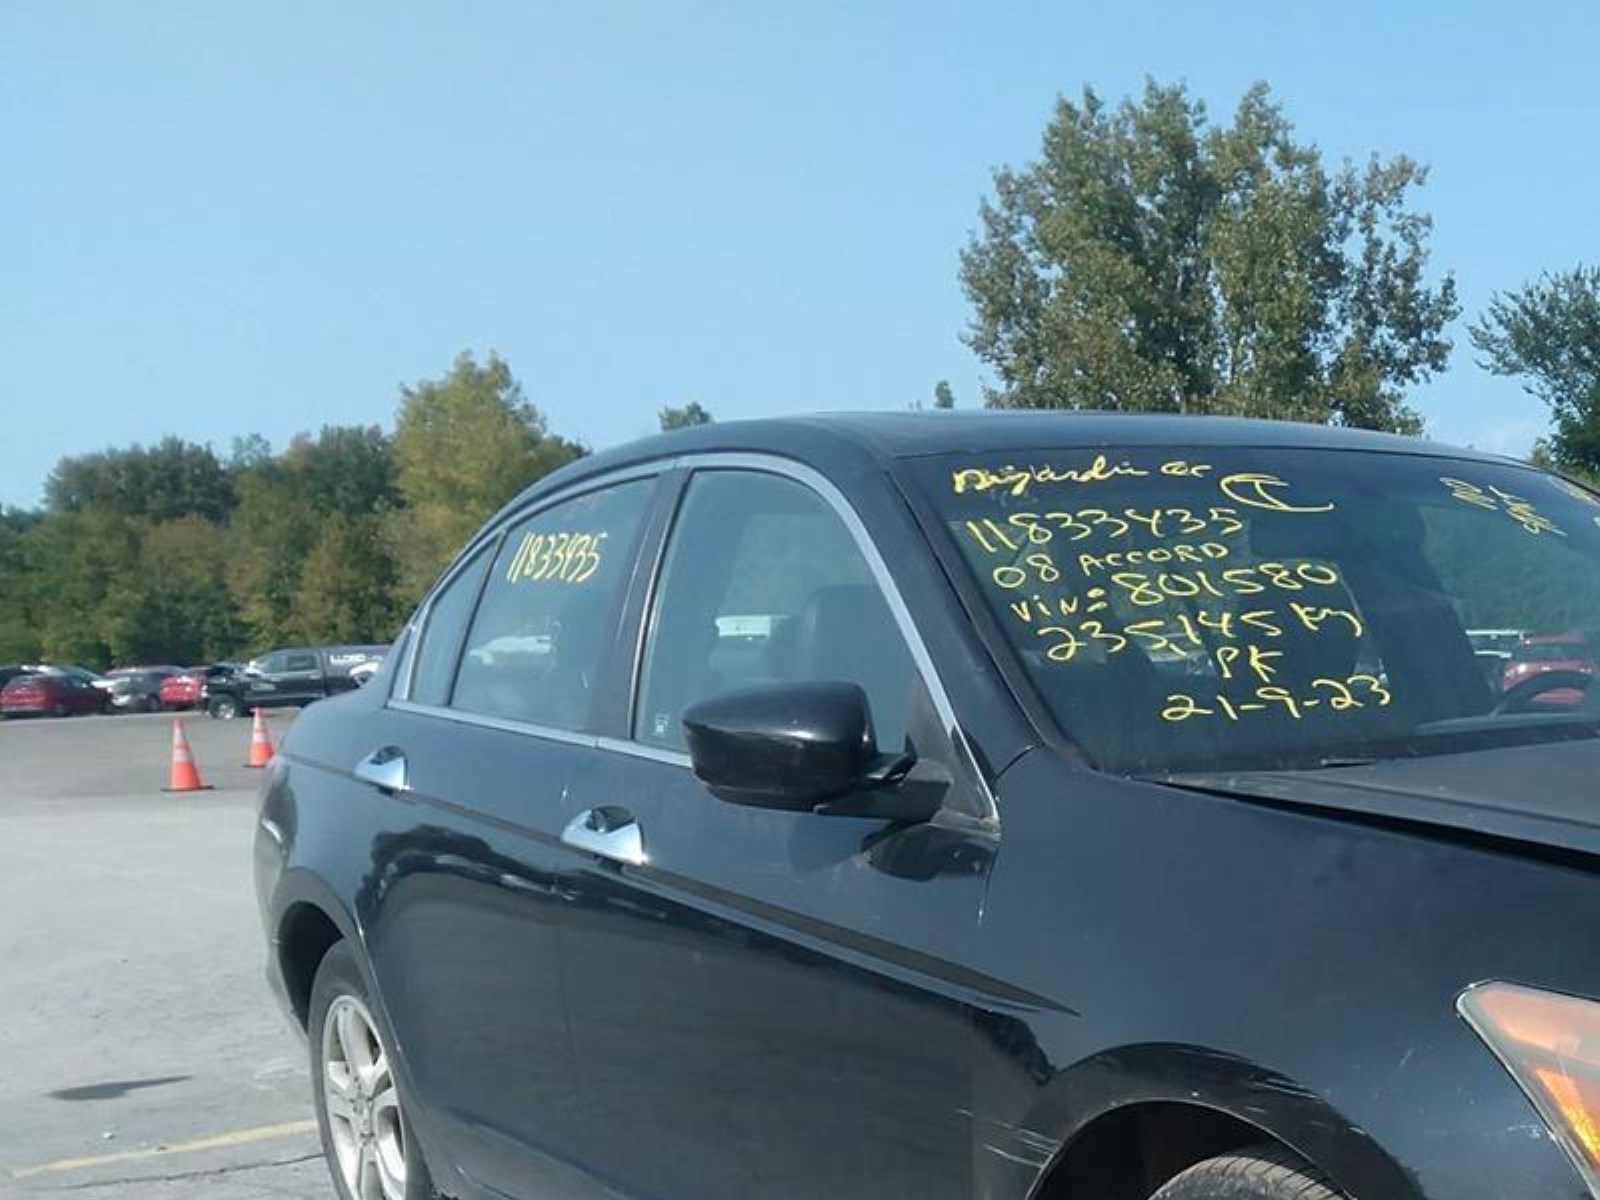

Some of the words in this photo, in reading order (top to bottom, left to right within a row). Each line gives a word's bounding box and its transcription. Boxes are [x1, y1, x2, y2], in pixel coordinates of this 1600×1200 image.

[965, 508, 1244, 552] 11833435
[505, 531, 609, 583] 11833435
[992, 554, 1060, 589] 08
[1079, 543, 1229, 576] ACCORD
[1112, 563, 1338, 605] 801580
[1160, 674, 1392, 721] 21-9-23
